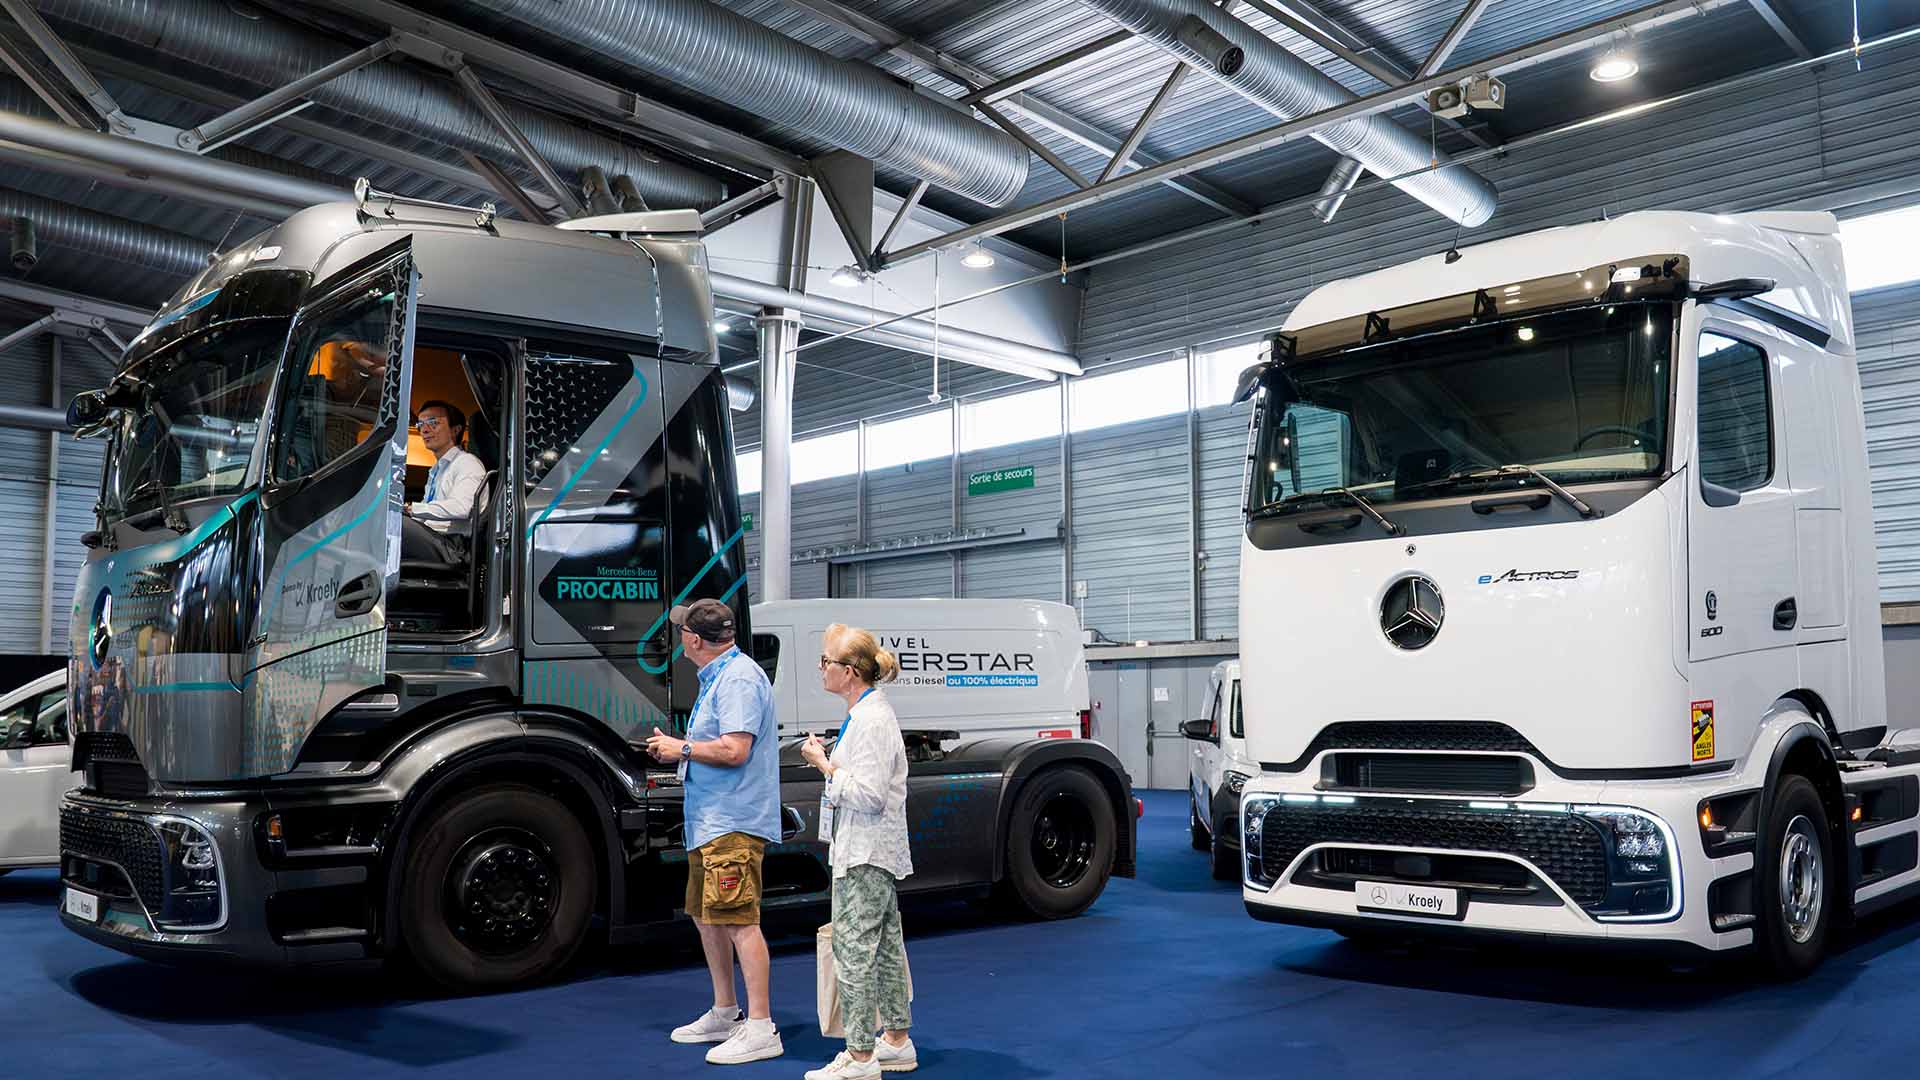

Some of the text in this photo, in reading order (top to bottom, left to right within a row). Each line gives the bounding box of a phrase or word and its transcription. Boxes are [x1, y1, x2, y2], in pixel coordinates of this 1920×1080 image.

[969, 468, 1033, 485] Sortie de secours
[596, 566, 657, 577] Mercedes-Benz
[306, 577, 340, 605] Kroely
[557, 581, 659, 600] PROCABIN
[898, 652, 1034, 672] ERSTAR
[913, 676, 945, 686] Diesel
[947, 677, 961, 686] ou
[962, 676, 988, 686] 100%
[989, 675, 1037, 687] électrique
[1408, 893, 1443, 911] Kroely
